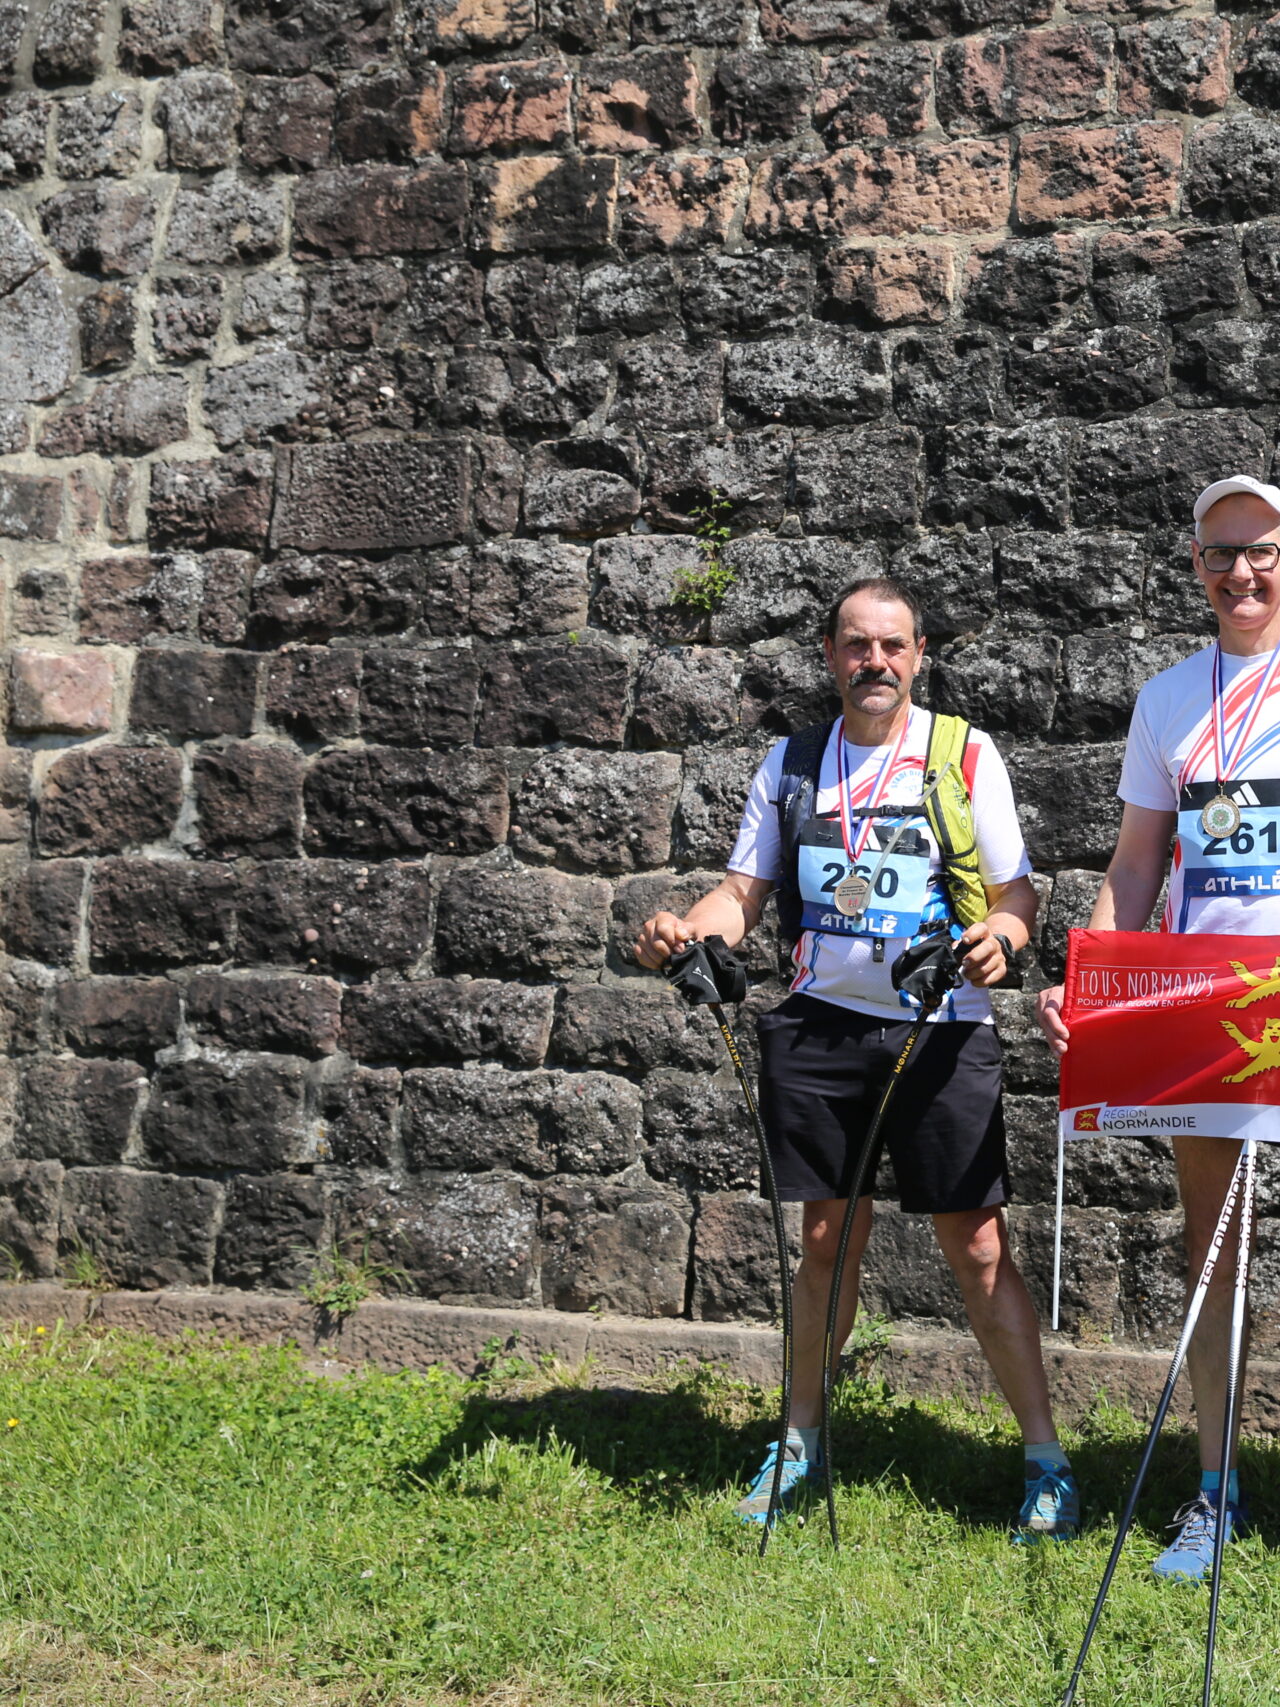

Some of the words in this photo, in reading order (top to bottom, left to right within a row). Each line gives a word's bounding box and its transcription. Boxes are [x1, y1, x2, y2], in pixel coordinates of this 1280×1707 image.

[909, 769, 922, 778] DIE
[1202, 821, 1278, 856] 261
[820, 862, 899, 899] 260
[1079, 970, 1122, 997] TOUS
[1127, 971, 1216, 998] NORMANDS
[1077, 997, 1104, 1007] POUR
[1106, 998, 1125, 1008] UNE
[1126, 997, 1159, 1008] RÉGION
[1162, 999, 1175, 1007] EN
[1177, 999, 1209, 1007] GRA
[1102, 1116, 1197, 1131] NORMANDIE
[1103, 1108, 1148, 1120] RÉGION
[1213, 1153, 1249, 1250] OUTDOOR
